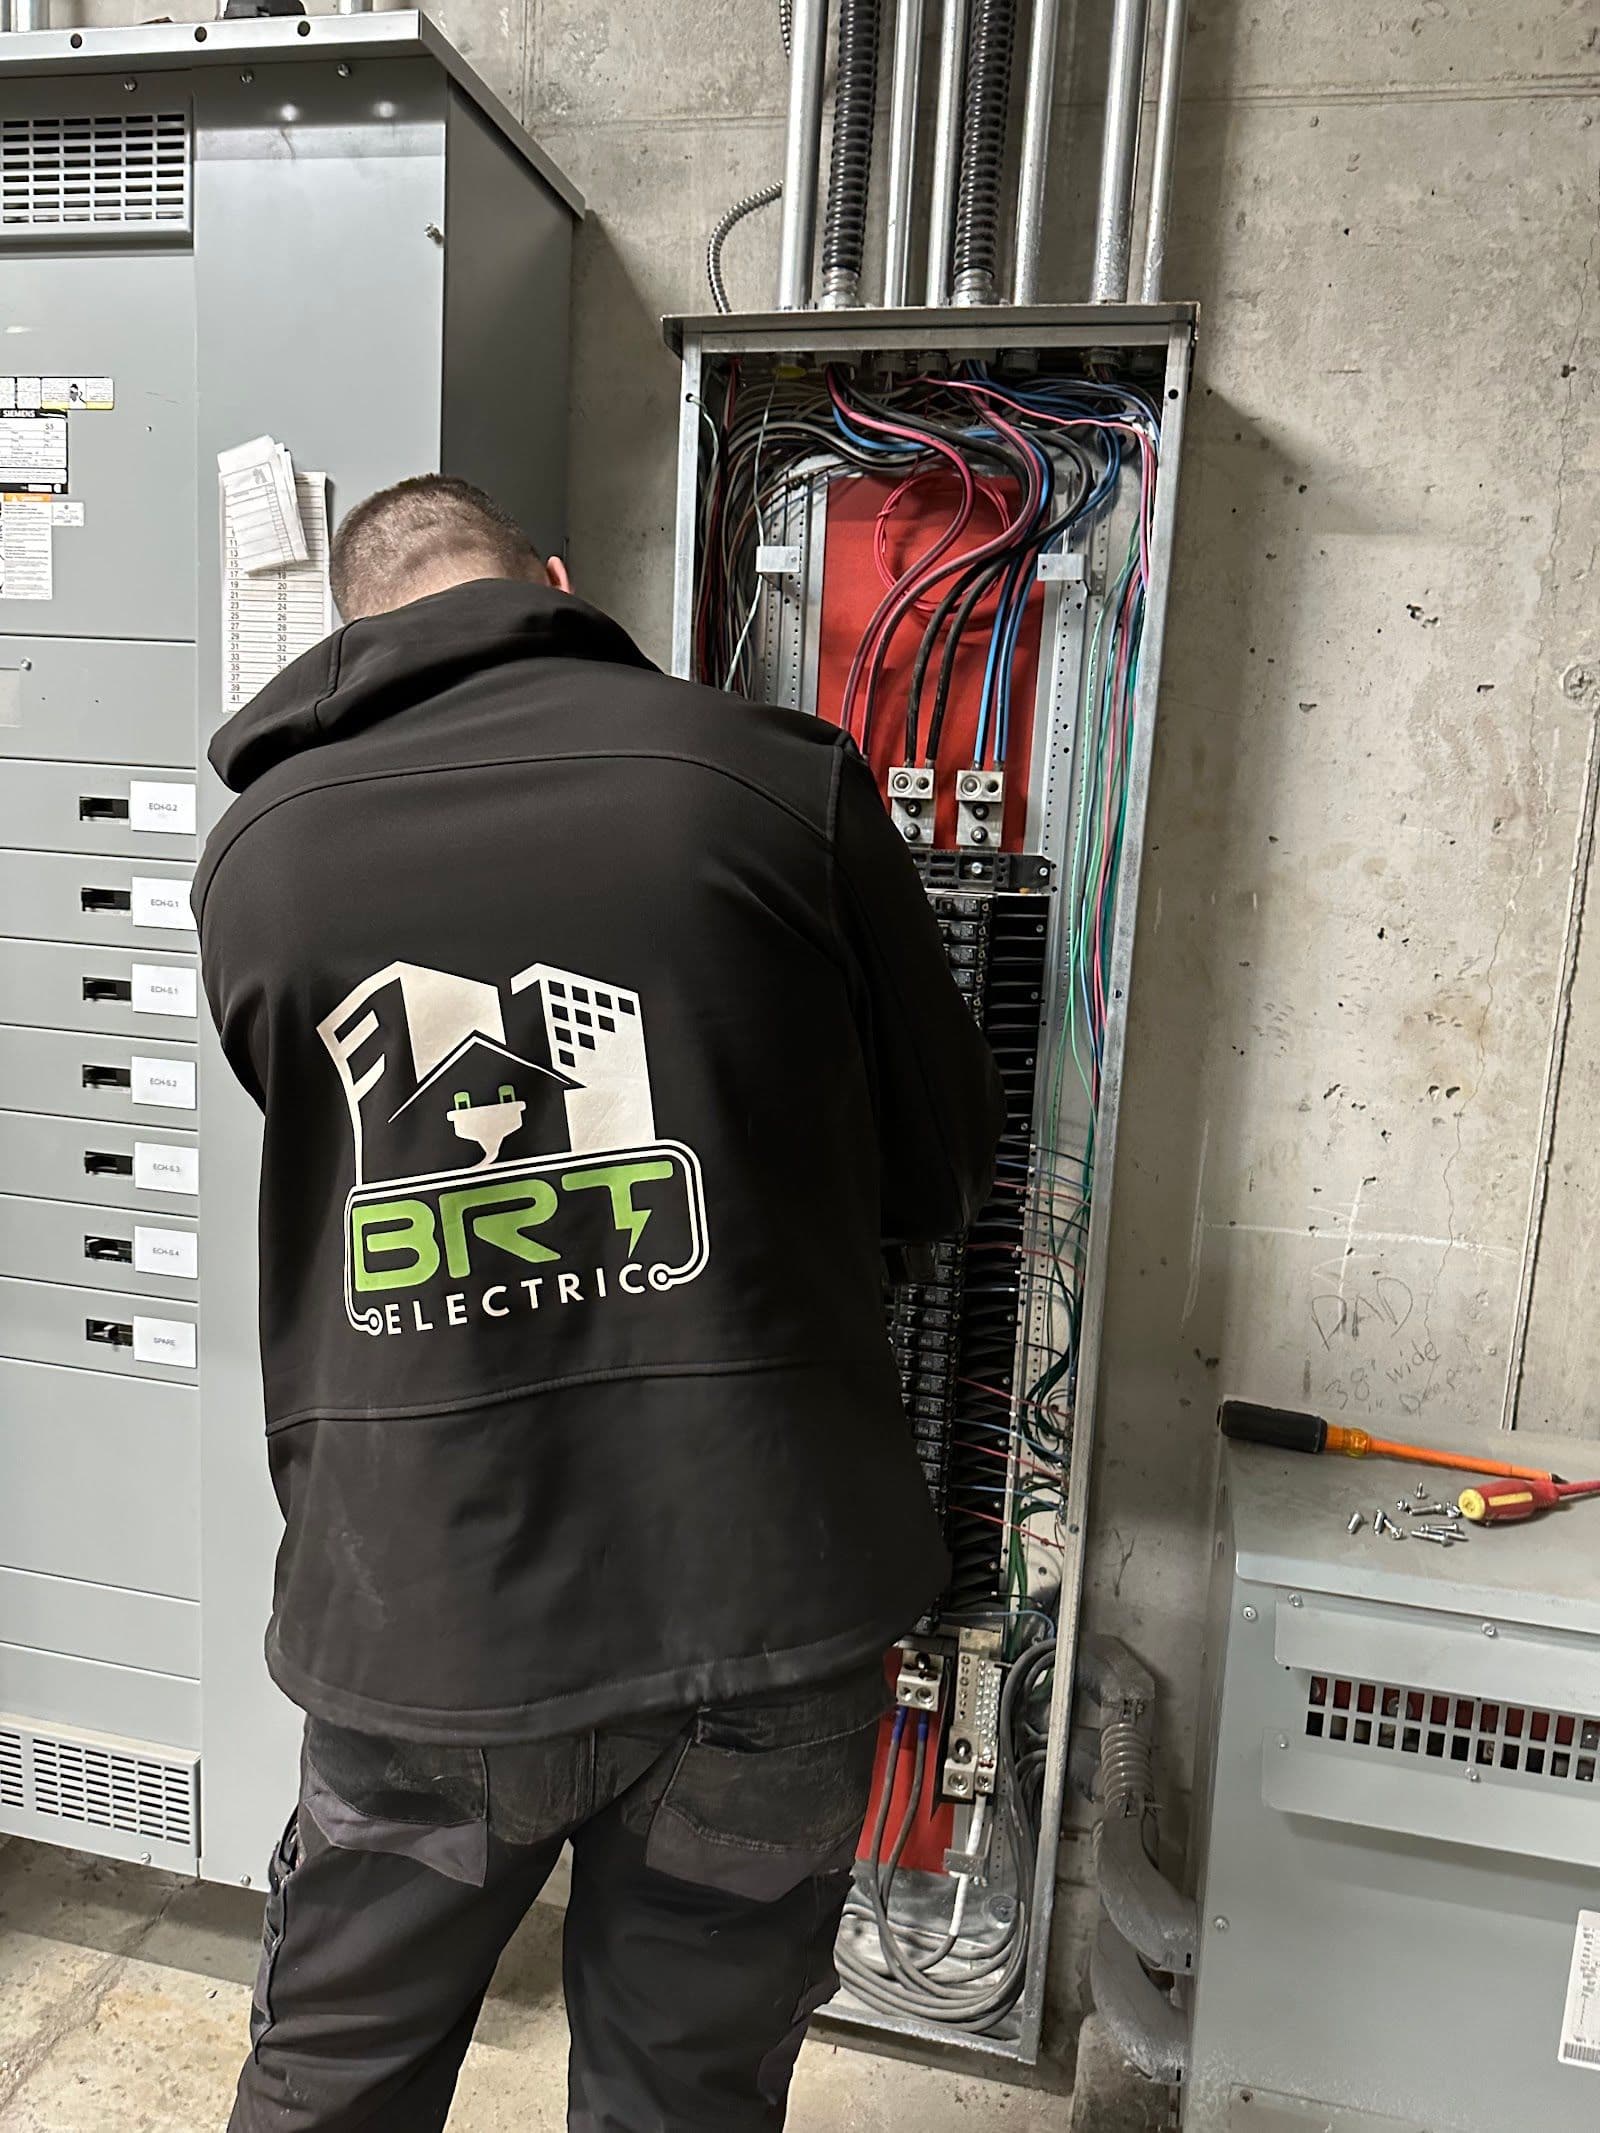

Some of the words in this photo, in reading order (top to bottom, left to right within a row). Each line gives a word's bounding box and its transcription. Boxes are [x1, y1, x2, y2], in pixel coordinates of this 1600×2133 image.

[3, 410, 36, 418] SIEMENS
[230, 560, 239, 568] 15
[230, 581, 239, 589] 19
[277, 582, 287, 590] 20
[230, 591, 239, 599] 21
[277, 592, 287, 600] 22
[277, 603, 287, 611] 24
[231, 612, 240, 620] 25
[277, 613, 287, 621] 26
[231, 622, 240, 630] 27
[277, 623, 287, 631] 28
[277, 634, 287, 642] 30
[277, 644, 287, 652] 32
[231, 653, 240, 661] 33
[351, 1160, 674, 1292] BRT
[385, 1262, 646, 1335] ELECTRIC
[1311, 1277, 1414, 1351] DAD
[153, 1337, 175, 1346] SPARE
